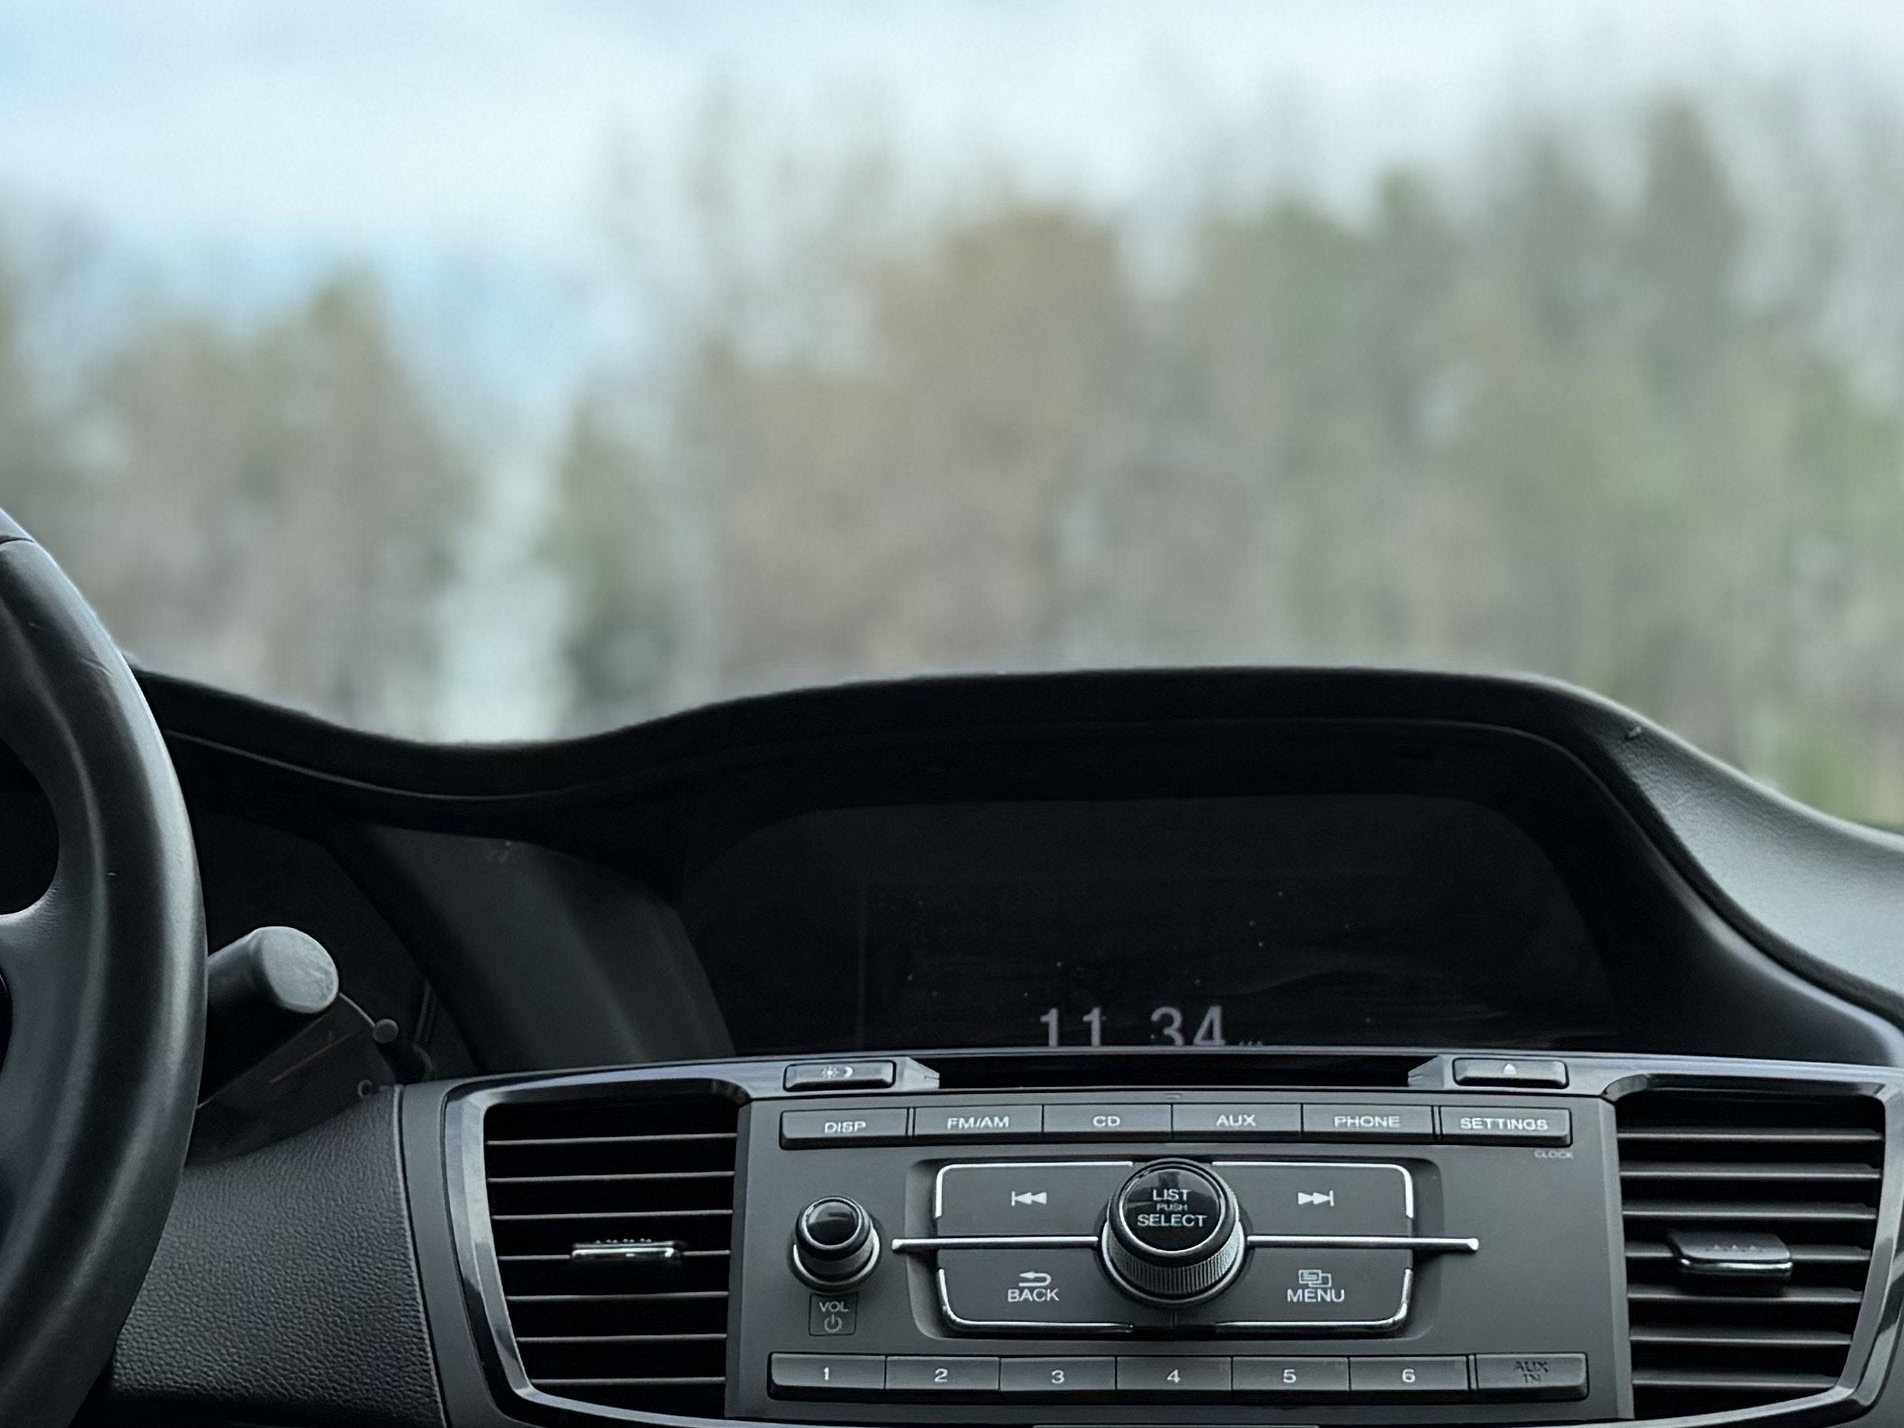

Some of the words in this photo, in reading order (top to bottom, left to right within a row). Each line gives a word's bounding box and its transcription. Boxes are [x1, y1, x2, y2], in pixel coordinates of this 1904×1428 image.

[824, 1120, 866, 1134] DISP
[947, 1115, 1010, 1130] FM/AM
[1092, 1115, 1121, 1128] CD
[1215, 1114, 1256, 1128] AUX
[1333, 1115, 1400, 1129] PHONE
[1459, 1117, 1549, 1131] SETTINGS
[1533, 1149, 1574, 1159] CLOCK
[1152, 1188, 1191, 1201] LIST
[1156, 1203, 1188, 1212] PUSH
[1137, 1213, 1208, 1228] SELECT
[1007, 1288, 1059, 1303] BACK
[1287, 1288, 1345, 1303] MENU
[818, 1301, 850, 1314] VOL
[1513, 1359, 1549, 1373] AUX
[823, 1366, 830, 1381] 1
[933, 1368, 948, 1383] 2
[1051, 1369, 1065, 1384] 3
[1166, 1368, 1180, 1383] 4
[1283, 1368, 1297, 1384] 5
[1401, 1368, 1416, 1384] 6
[1523, 1373, 1541, 1384] IN
